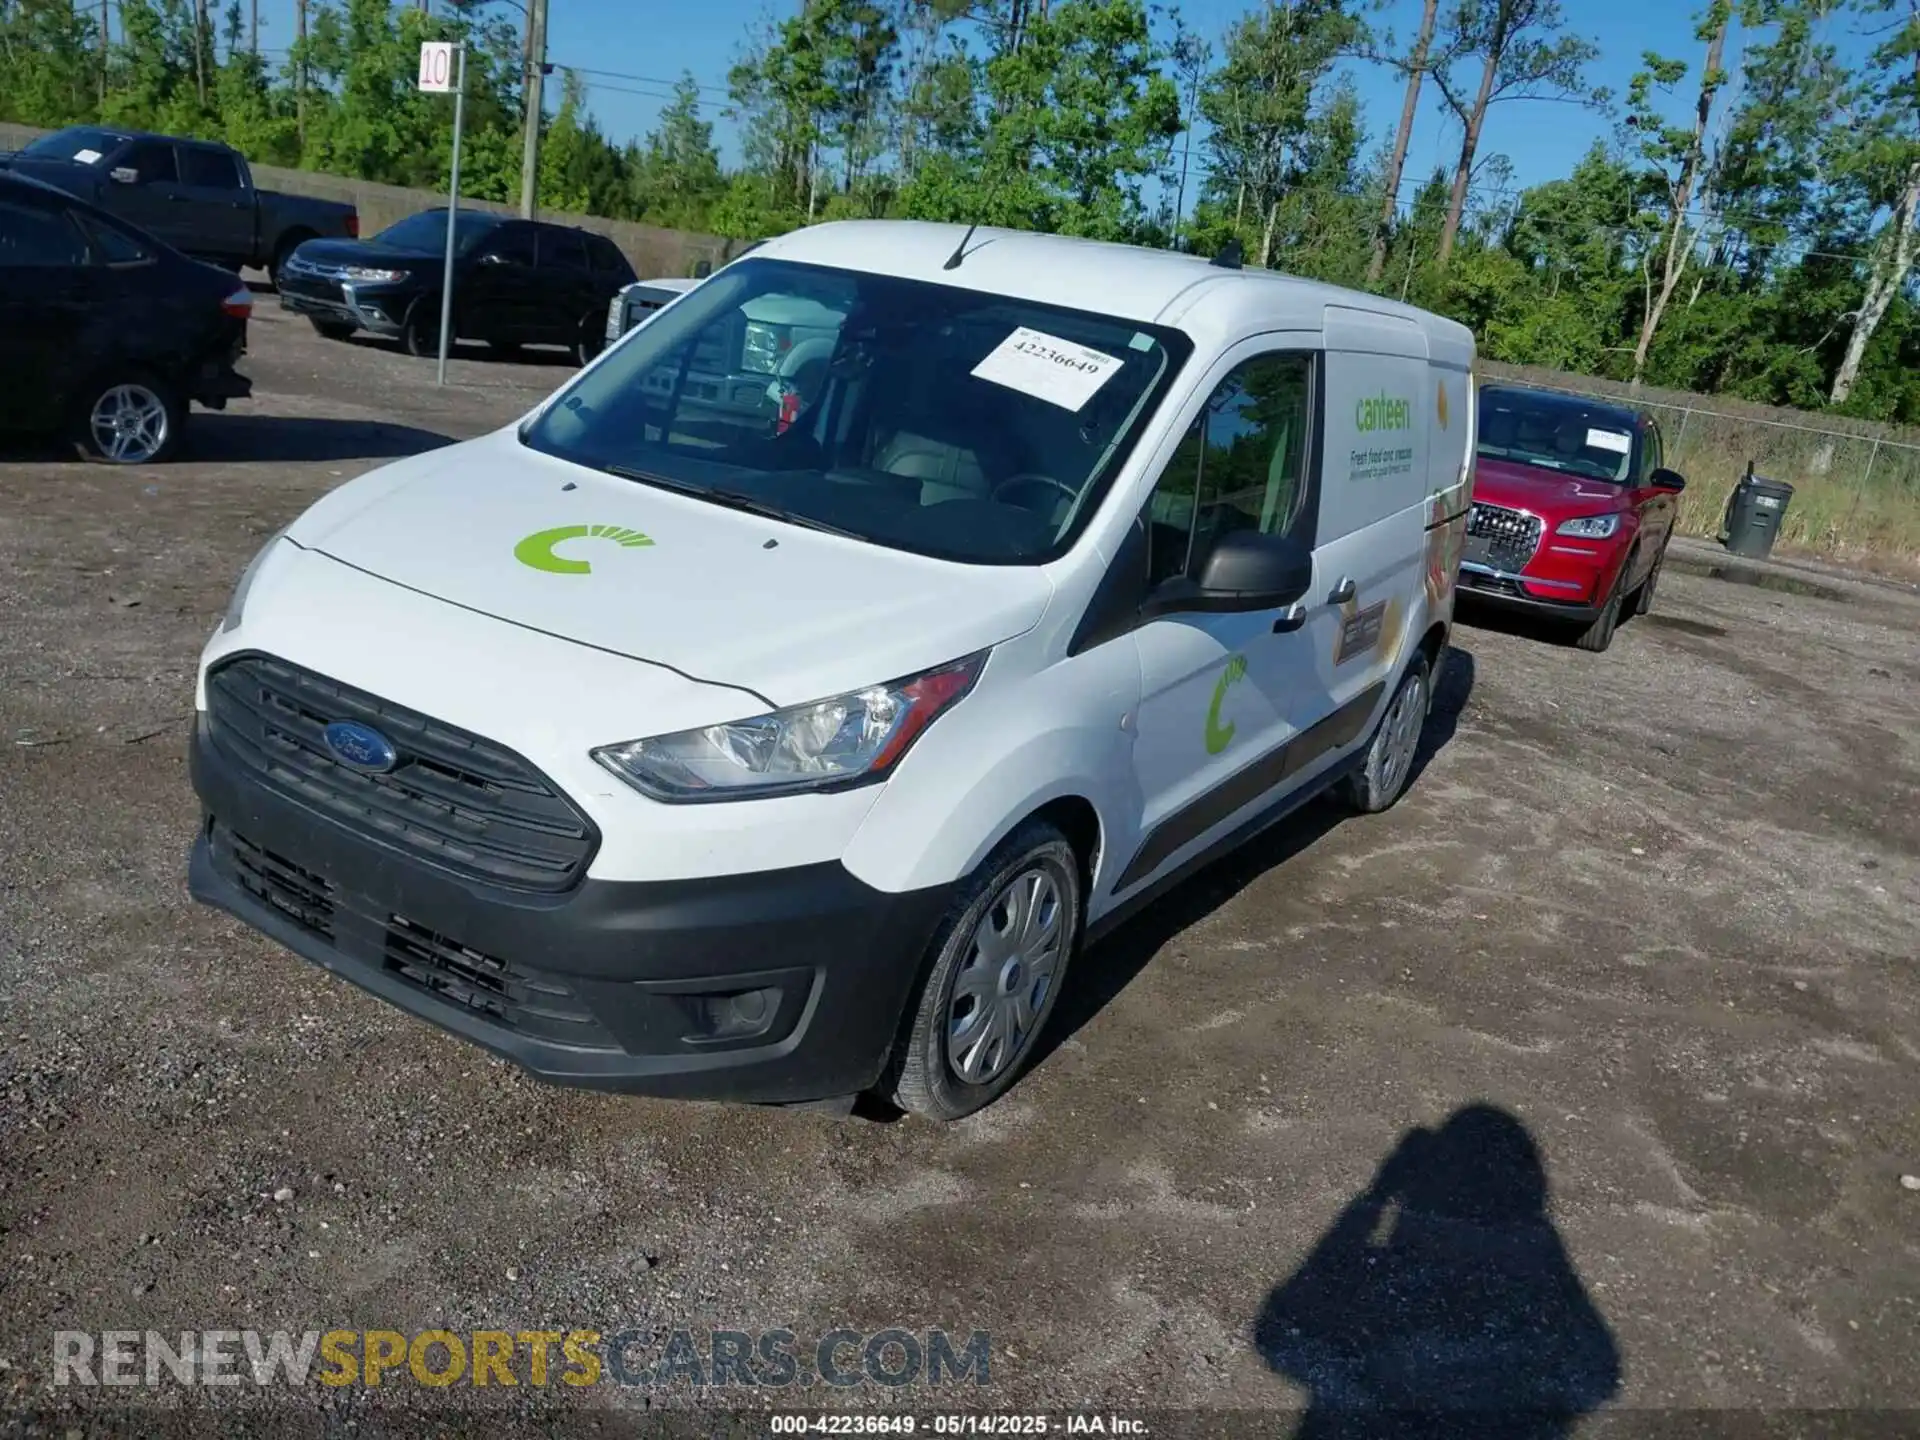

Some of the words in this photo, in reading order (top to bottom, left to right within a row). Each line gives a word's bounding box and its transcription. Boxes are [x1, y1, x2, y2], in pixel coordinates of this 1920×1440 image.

[420, 48, 448, 85] 10
[1013, 340, 1100, 375] 42236649
[1356, 388, 1410, 433] canteen
